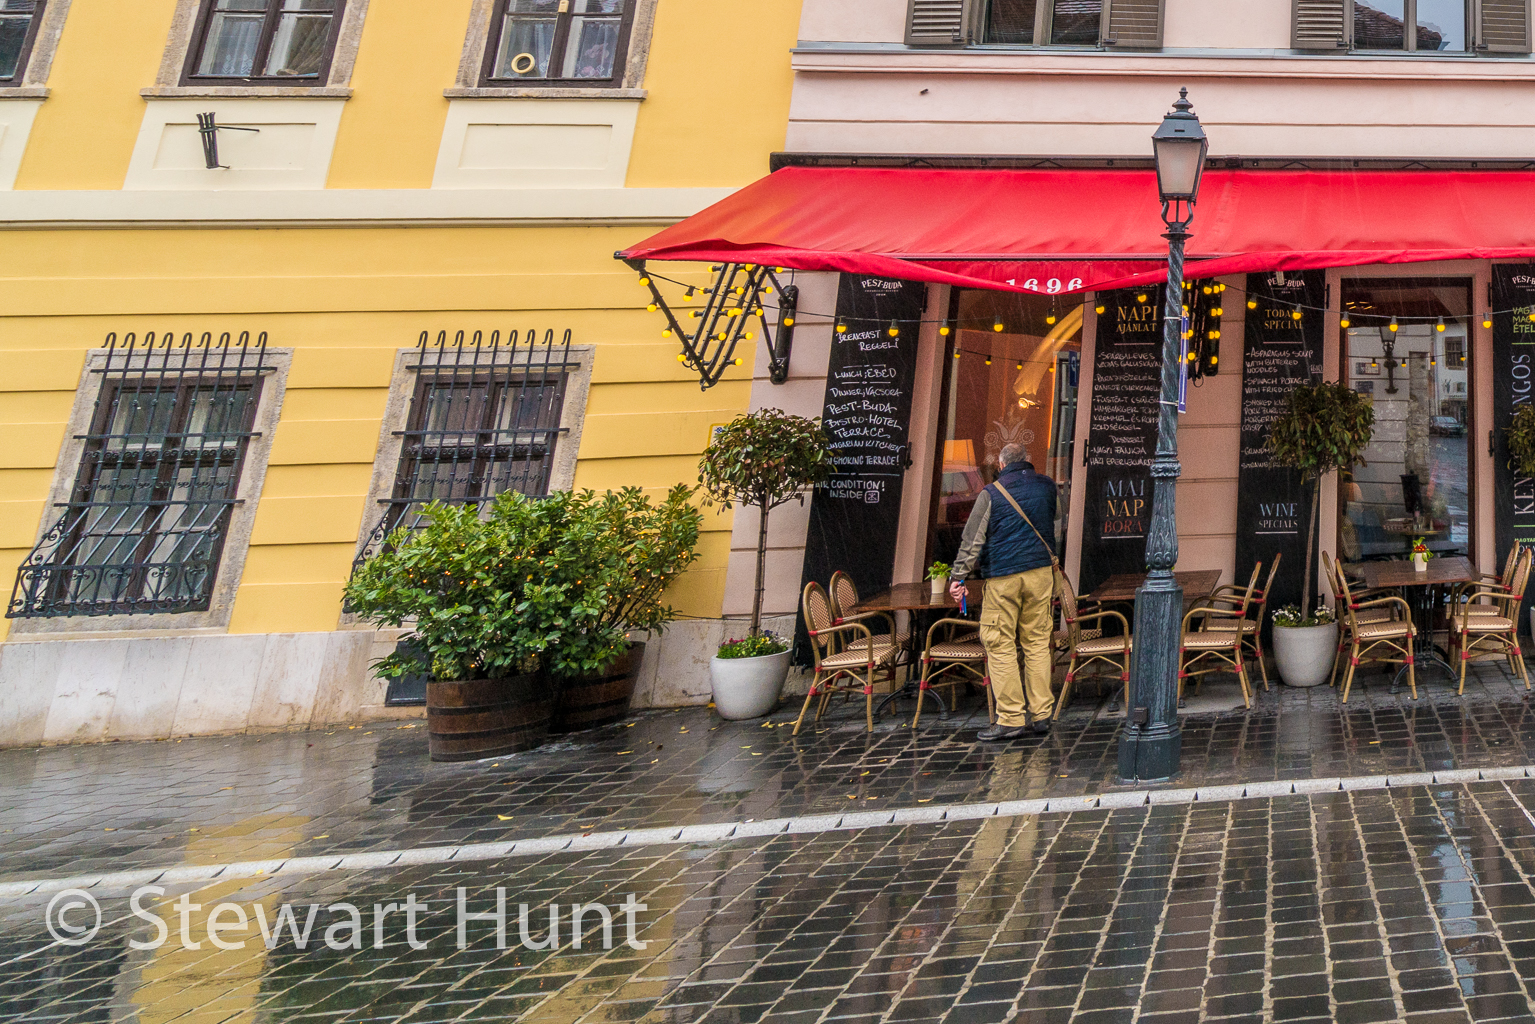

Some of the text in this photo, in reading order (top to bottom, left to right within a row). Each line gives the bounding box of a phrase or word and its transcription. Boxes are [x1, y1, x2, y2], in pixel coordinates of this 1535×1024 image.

[1117, 305, 1157, 322] NAPI
[1116, 321, 1157, 334] AJÁNLAT
[834, 427, 891, 438] TERRACE
[865, 440, 905, 452] KITCHEN
[833, 456, 864, 465] SMOKING
[829, 490, 863, 499] INSIDE
[1106, 479, 1145, 497] MAI
[1106, 499, 1144, 517] NAP
[1260, 503, 1297, 516] WINE
[1104, 520, 1143, 533] BORA
[1259, 520, 1298, 528] SPECIALS
